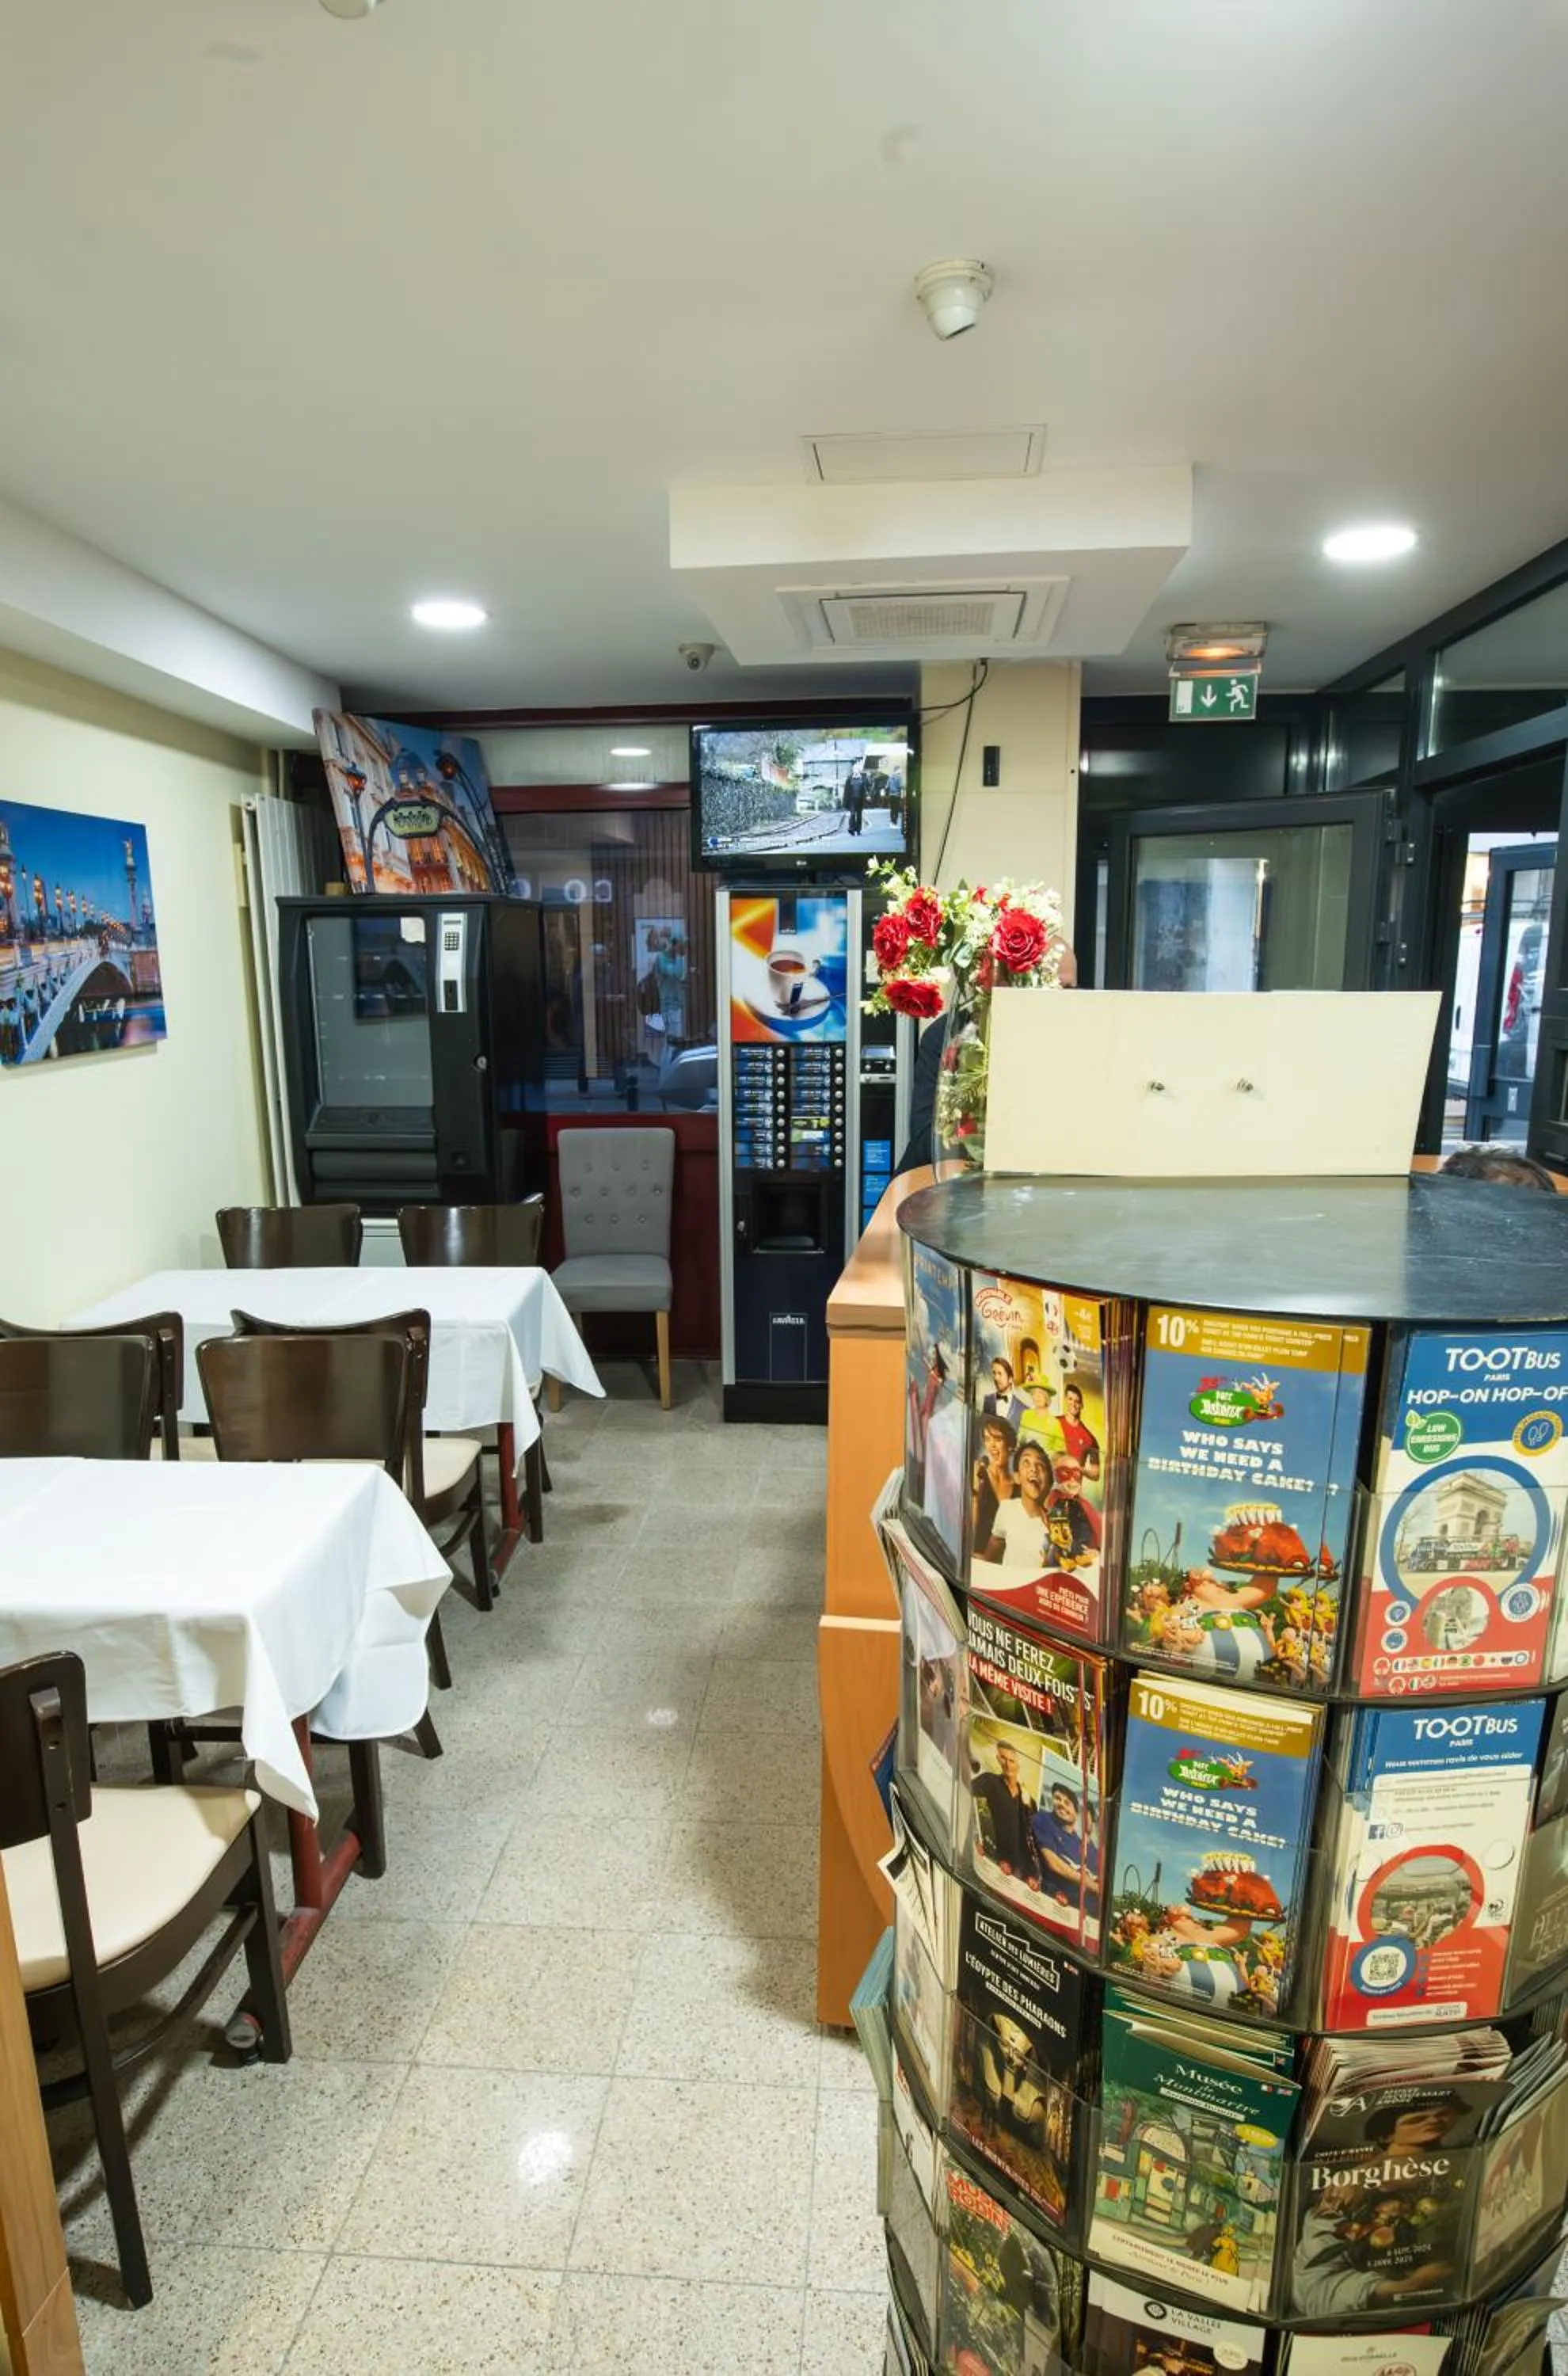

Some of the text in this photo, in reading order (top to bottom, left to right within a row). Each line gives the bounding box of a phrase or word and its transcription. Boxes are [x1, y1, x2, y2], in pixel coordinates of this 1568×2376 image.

[1157, 1314, 1200, 1347] 10%
[1406, 1388, 1490, 1405] HOP-ON
[1180, 1445, 1283, 1472] WE NEED A
[1182, 1430, 1284, 1456] WHO SAYS
[1148, 1456, 1315, 1493] BIRTHDAY CAKE?
[995, 1628, 1013, 1652] NE
[1015, 1639, 1056, 1673] FEREZ
[1008, 1655, 1041, 1688] DEUX
[1011, 1677, 1045, 1711] VISITE
[1138, 1690, 1178, 1721] 10%
[1130, 1801, 1223, 1833] BIRTHDAY
[1159, 1797, 1257, 1829] WE NEED A
[1162, 1786, 1258, 1817] WHO SAYS
[1002, 1978, 1019, 2001] DES
[1020, 1992, 1067, 2039] PHARAONS
[1153, 2073, 1261, 2116] Montmartre
[1175, 2063, 1243, 2095] Musée
[1311, 2157, 1450, 2191] Borghèse
